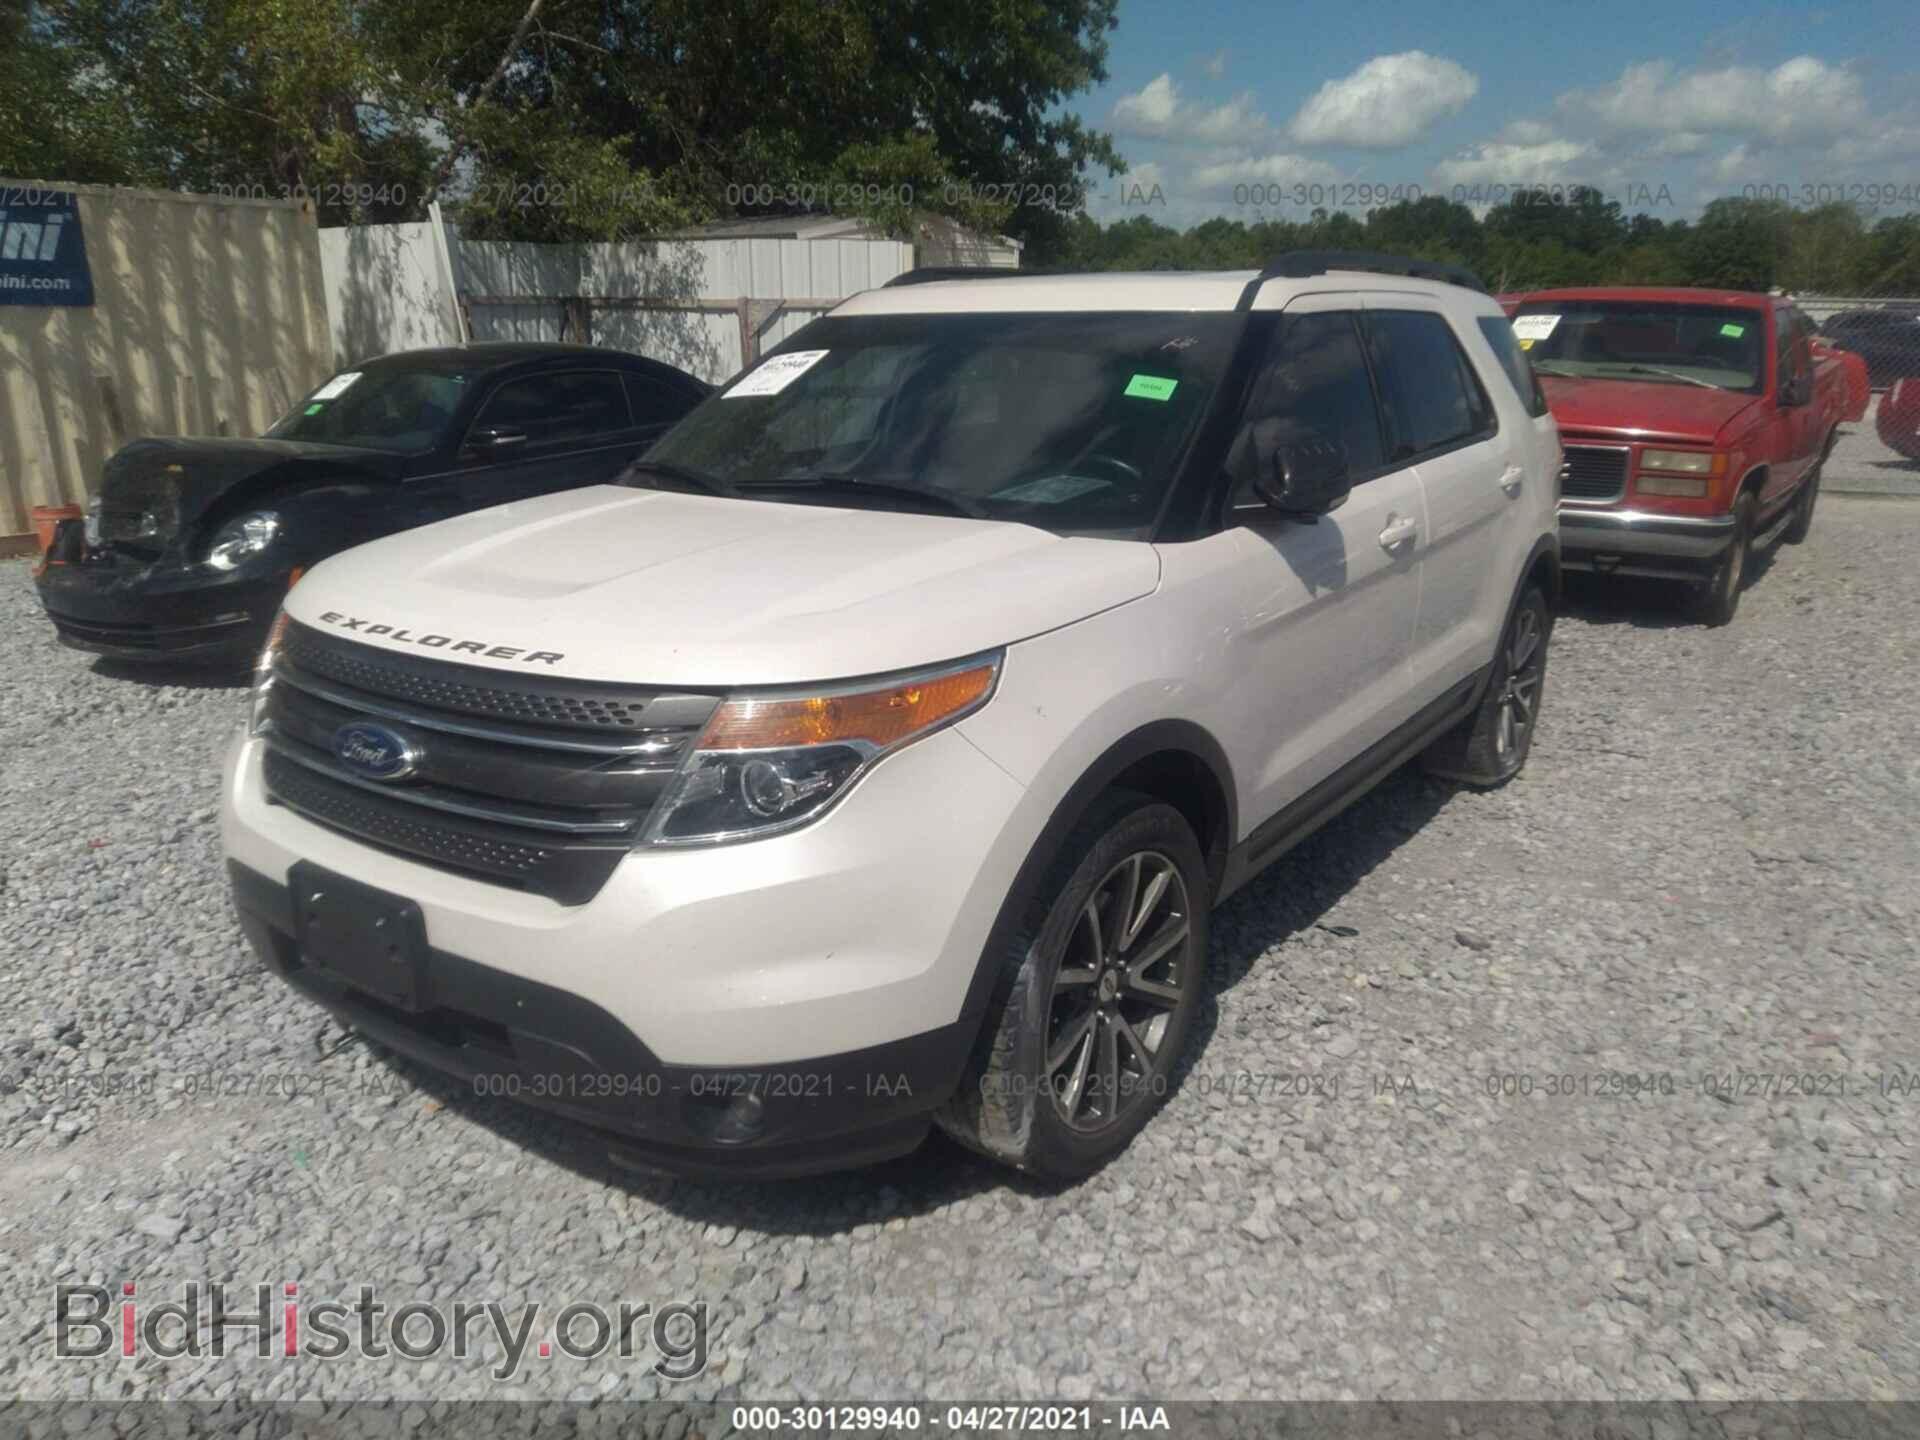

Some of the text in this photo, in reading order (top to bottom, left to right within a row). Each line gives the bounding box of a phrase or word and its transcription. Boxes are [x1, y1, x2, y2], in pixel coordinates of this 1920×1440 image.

[0, 272, 71, 290] ini.com
[319, 611, 565, 665] EXPLORER
[341, 730, 387, 763] Ford
